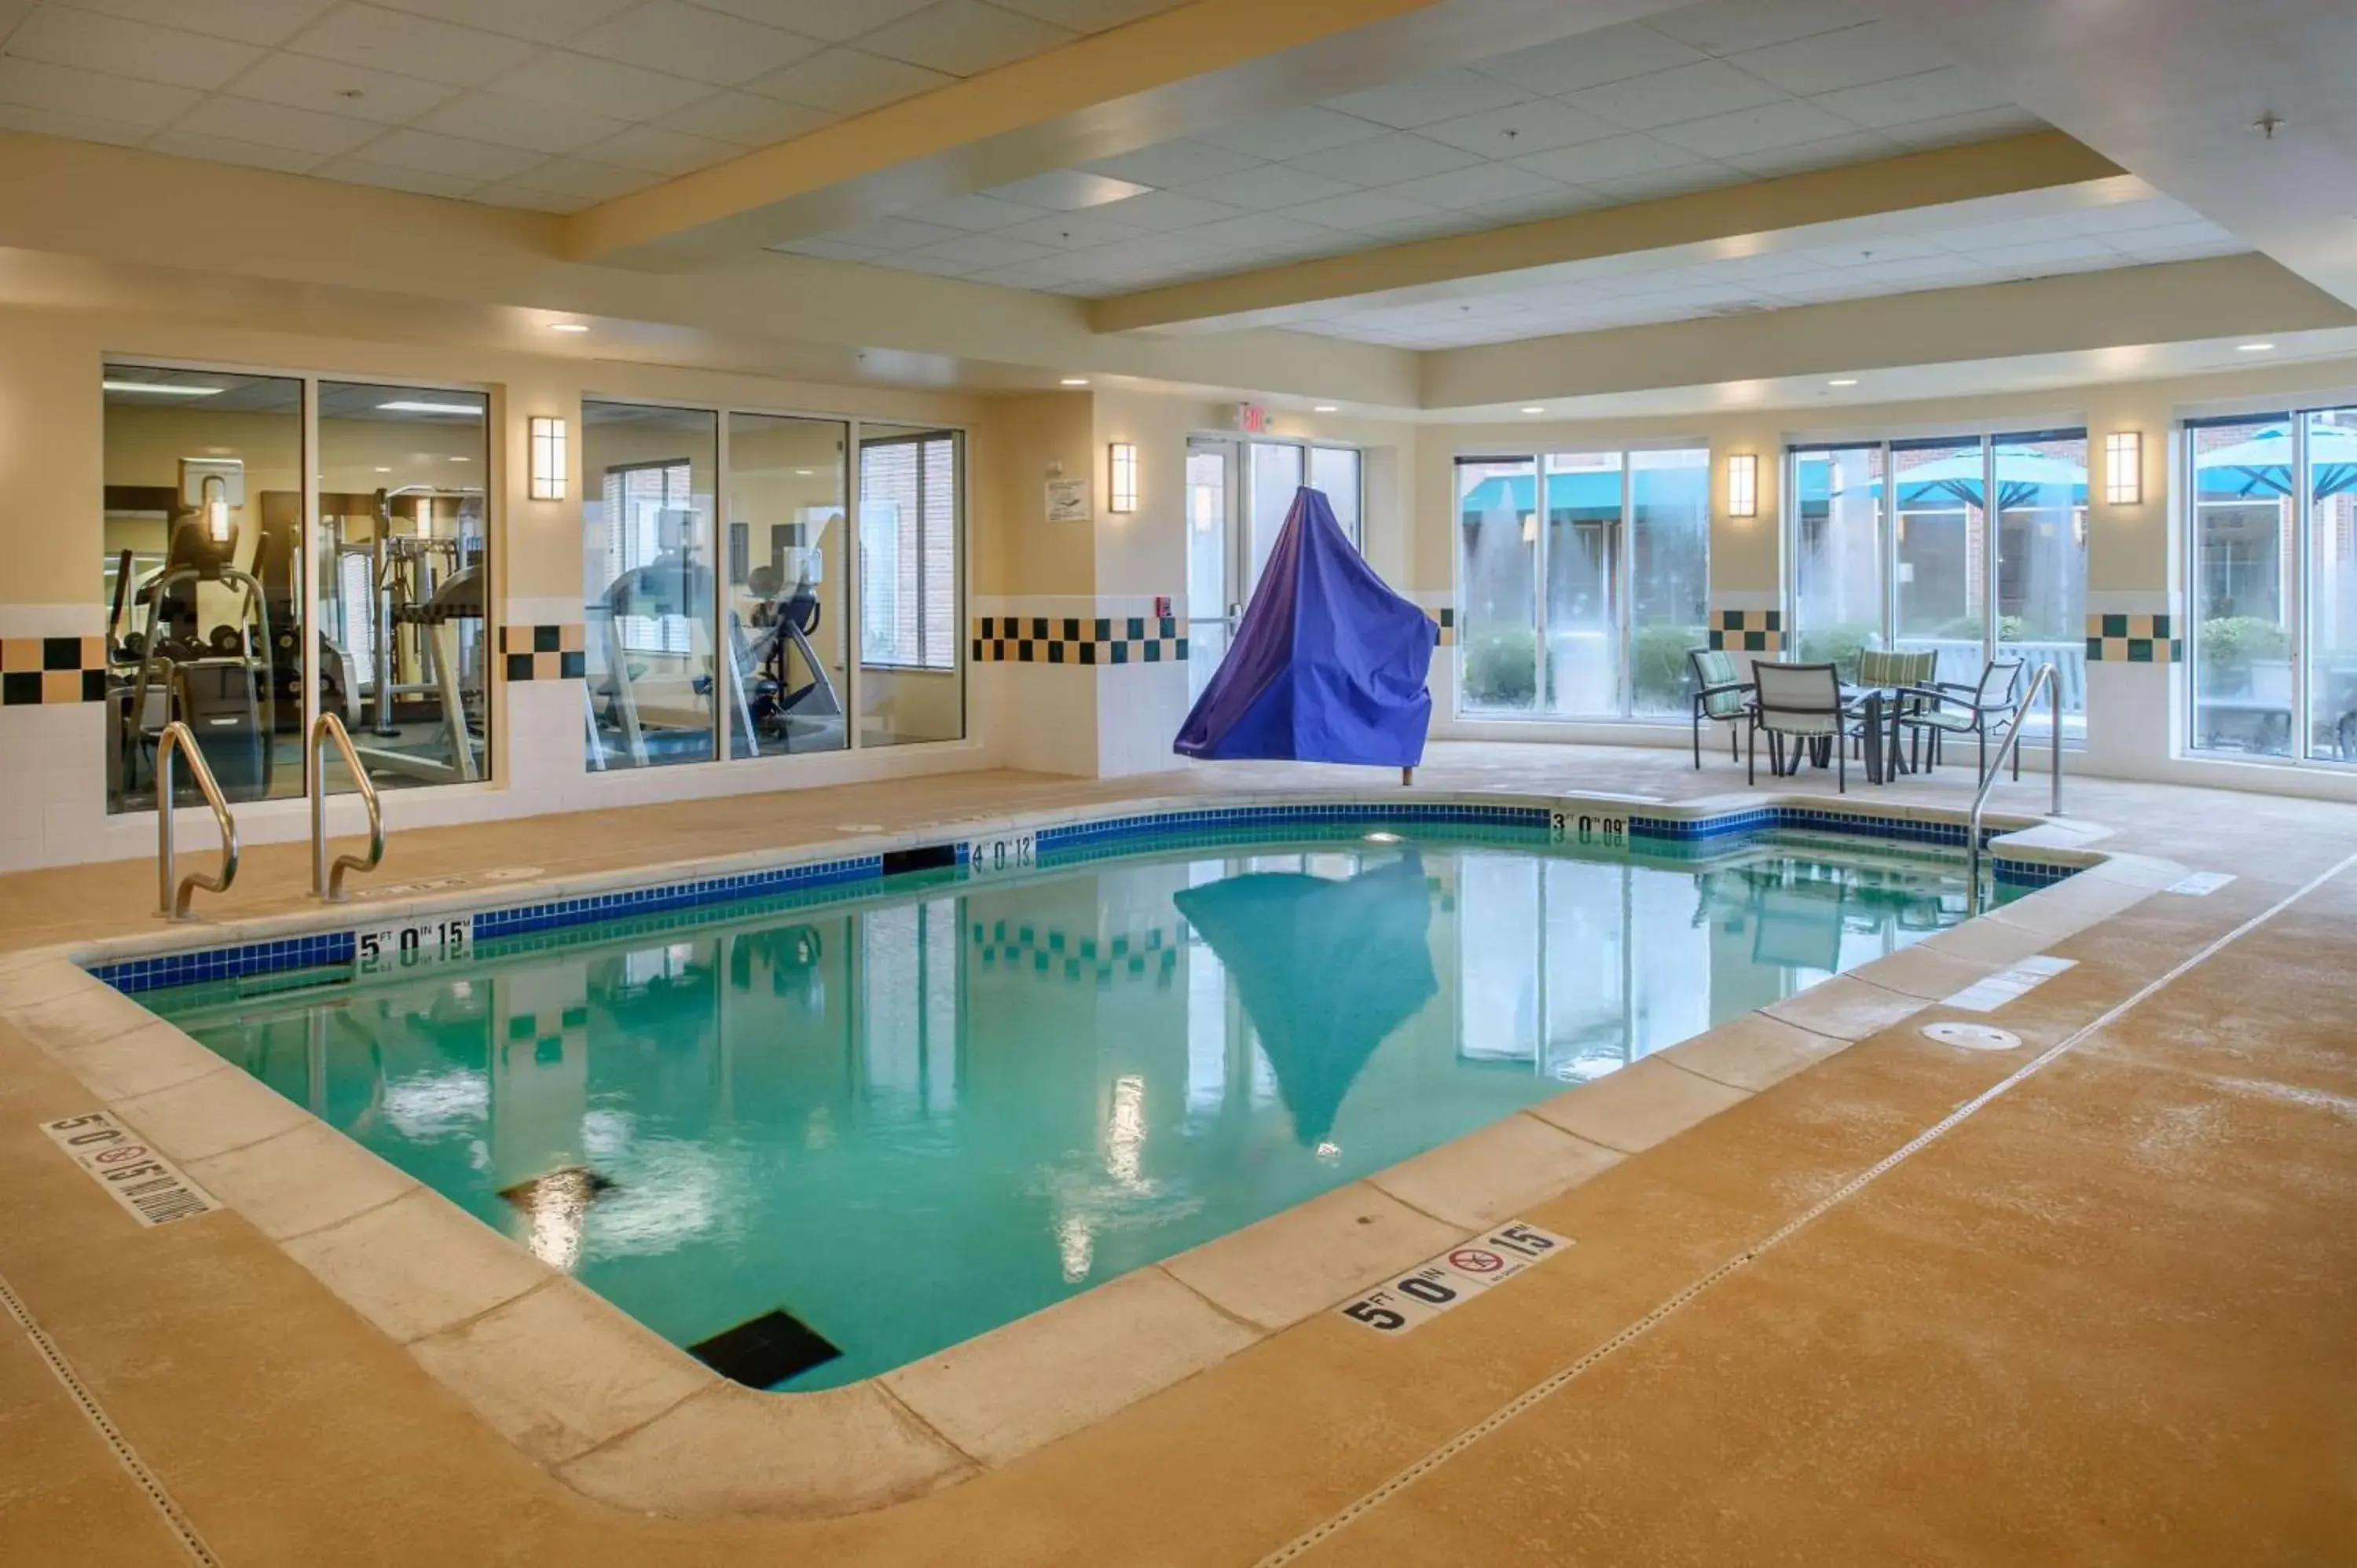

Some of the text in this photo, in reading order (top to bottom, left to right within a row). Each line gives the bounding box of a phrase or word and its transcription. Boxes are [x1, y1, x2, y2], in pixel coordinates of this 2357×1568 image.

[1553, 813, 1565, 829] 3
[973, 844, 983, 860] 4
[361, 933, 379, 957] 5
[379, 931, 393, 941] FT
[438, 921, 463, 946] 15
[51, 1114, 104, 1130] 5
[68, 1130, 121, 1145] 0
[100, 1160, 163, 1181] 15
[1489, 1228, 1554, 1255] 15
[1418, 1267, 1446, 1280] IN
[1397, 1277, 1457, 1303] 0
[1368, 1291, 1395, 1306] FT
[1342, 1301, 1406, 1330] 5
